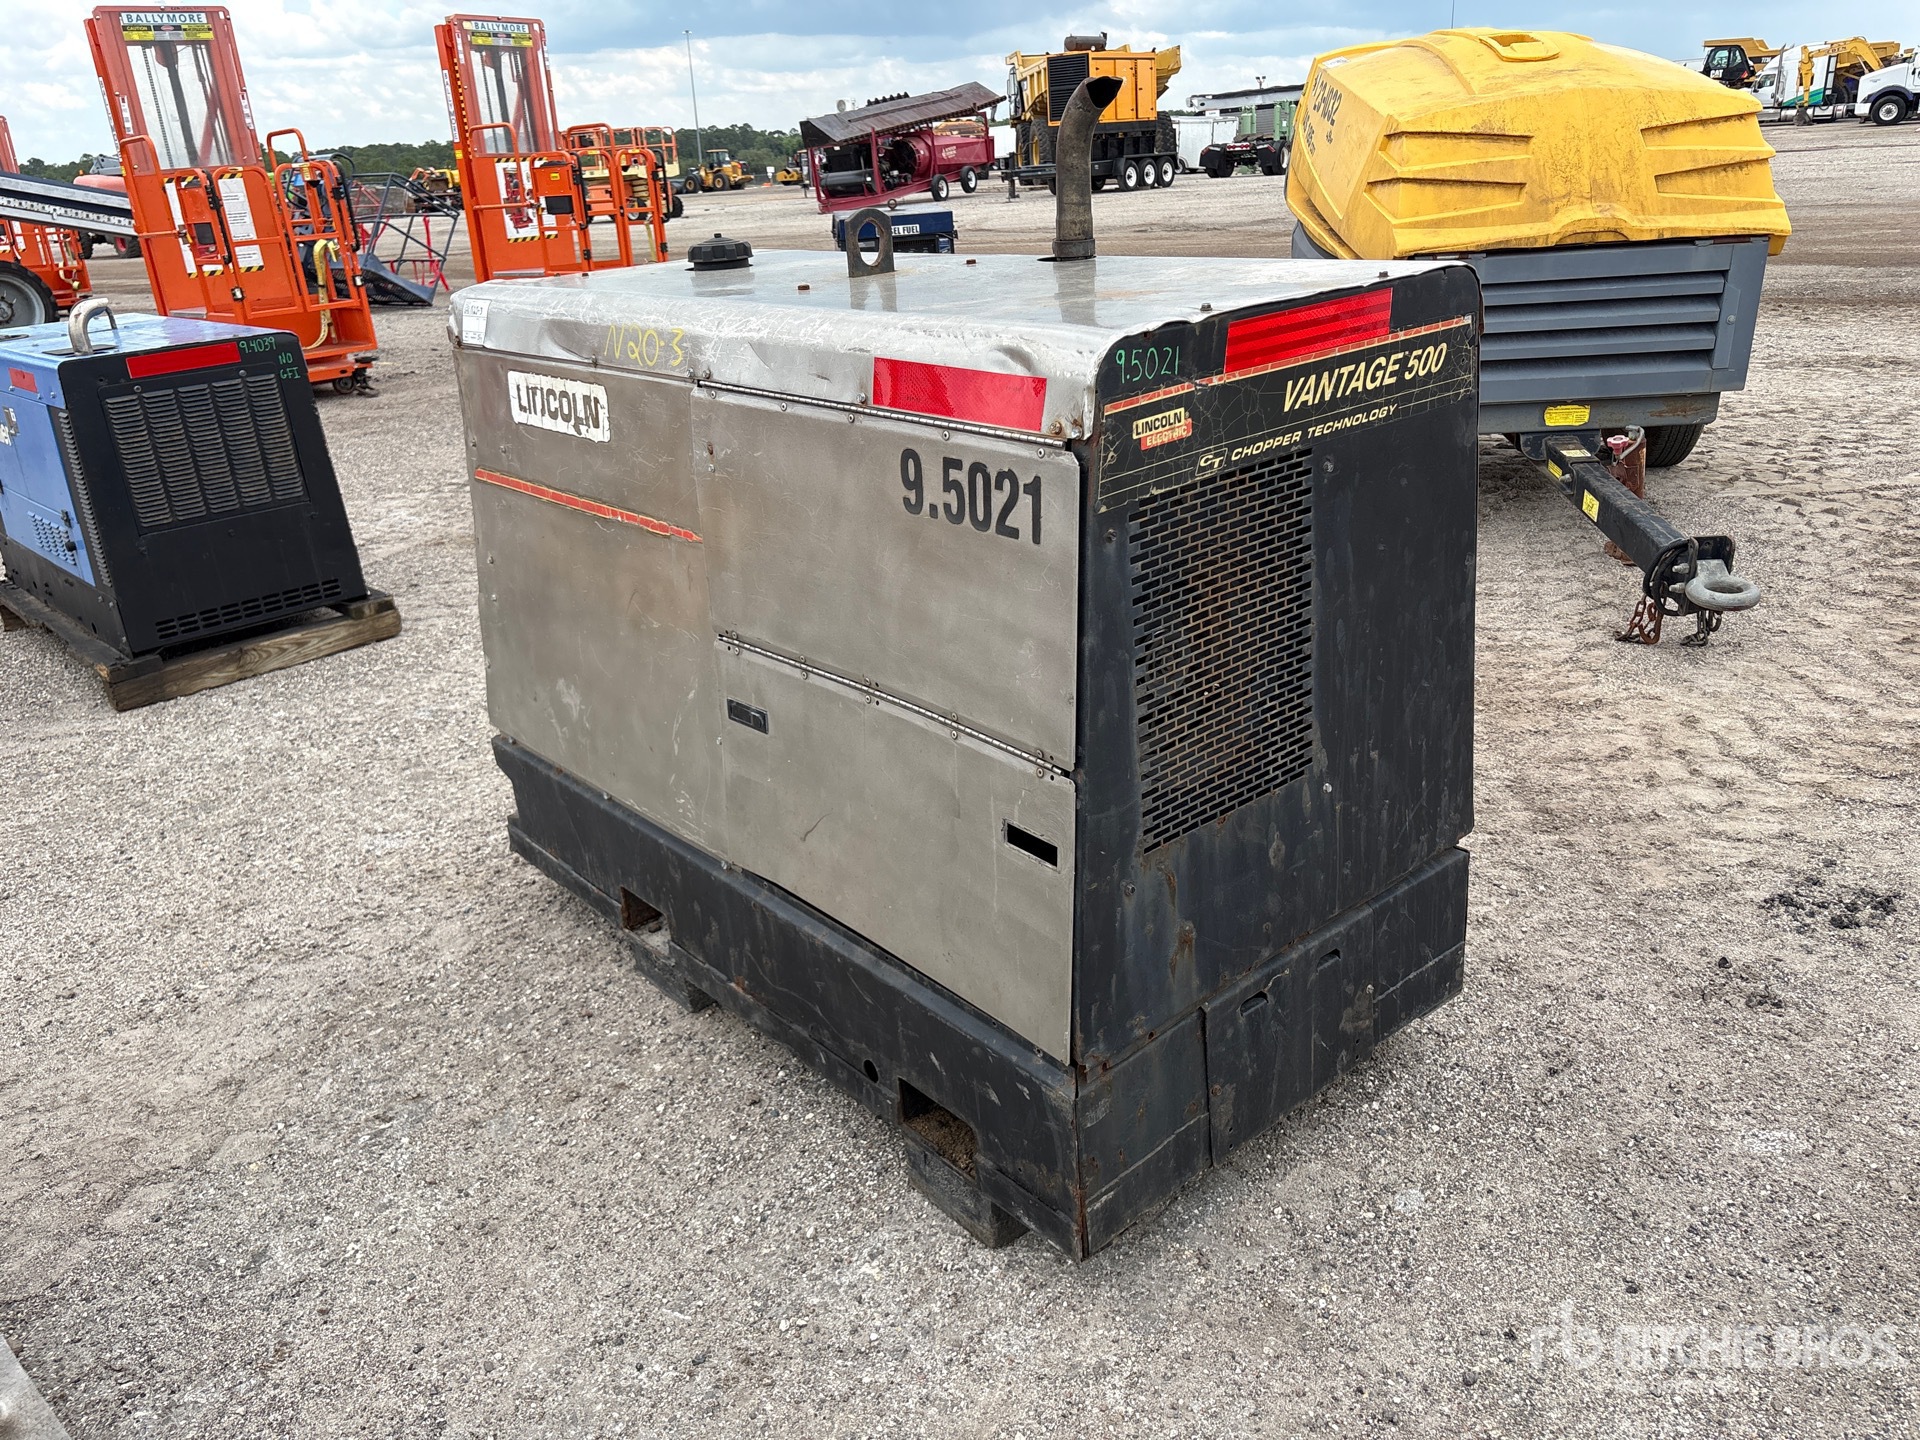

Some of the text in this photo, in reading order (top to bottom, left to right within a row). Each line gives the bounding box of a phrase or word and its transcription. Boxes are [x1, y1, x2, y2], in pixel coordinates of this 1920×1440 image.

[126, 13, 204, 23] BALLYMORE
[474, 22, 527, 33] BALLYMORE
[1710, 69, 1723, 79] CAT
[902, 225, 919, 234] FUEL
[239, 336, 276, 353] 9.4039
[278, 352, 293, 364] NO
[1116, 345, 1180, 384] 9.5021
[280, 366, 301, 379] GFI
[1283, 342, 1448, 413] VANTAGE 500
[1135, 410, 1182, 436] LINCOLN
[1230, 430, 1302, 462] CHOPPER
[1307, 403, 1399, 439] TECHNOLOGY
[901, 448, 1042, 545] 9.5021
